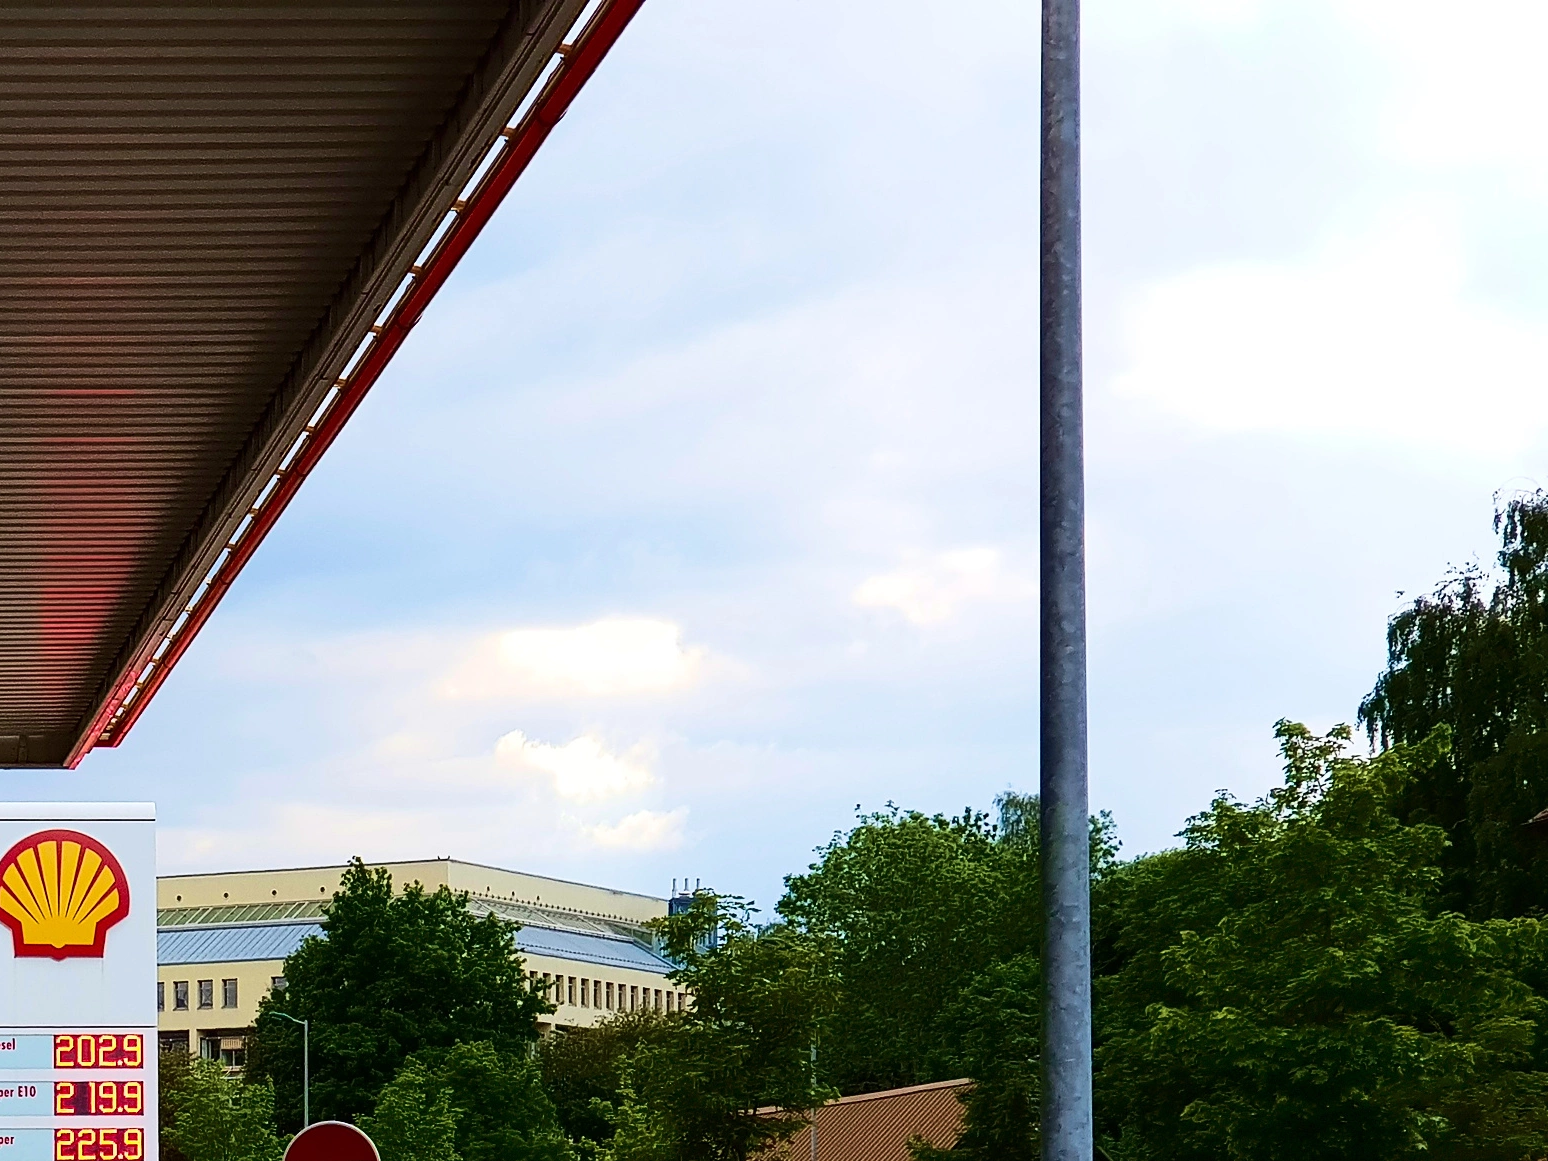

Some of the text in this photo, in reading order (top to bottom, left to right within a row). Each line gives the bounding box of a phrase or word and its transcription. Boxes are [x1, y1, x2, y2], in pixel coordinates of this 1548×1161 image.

[56, 1035, 142, 1067] 202.9
[18, 1086, 37, 1097] E10
[56, 1129, 143, 1161] 225.9
